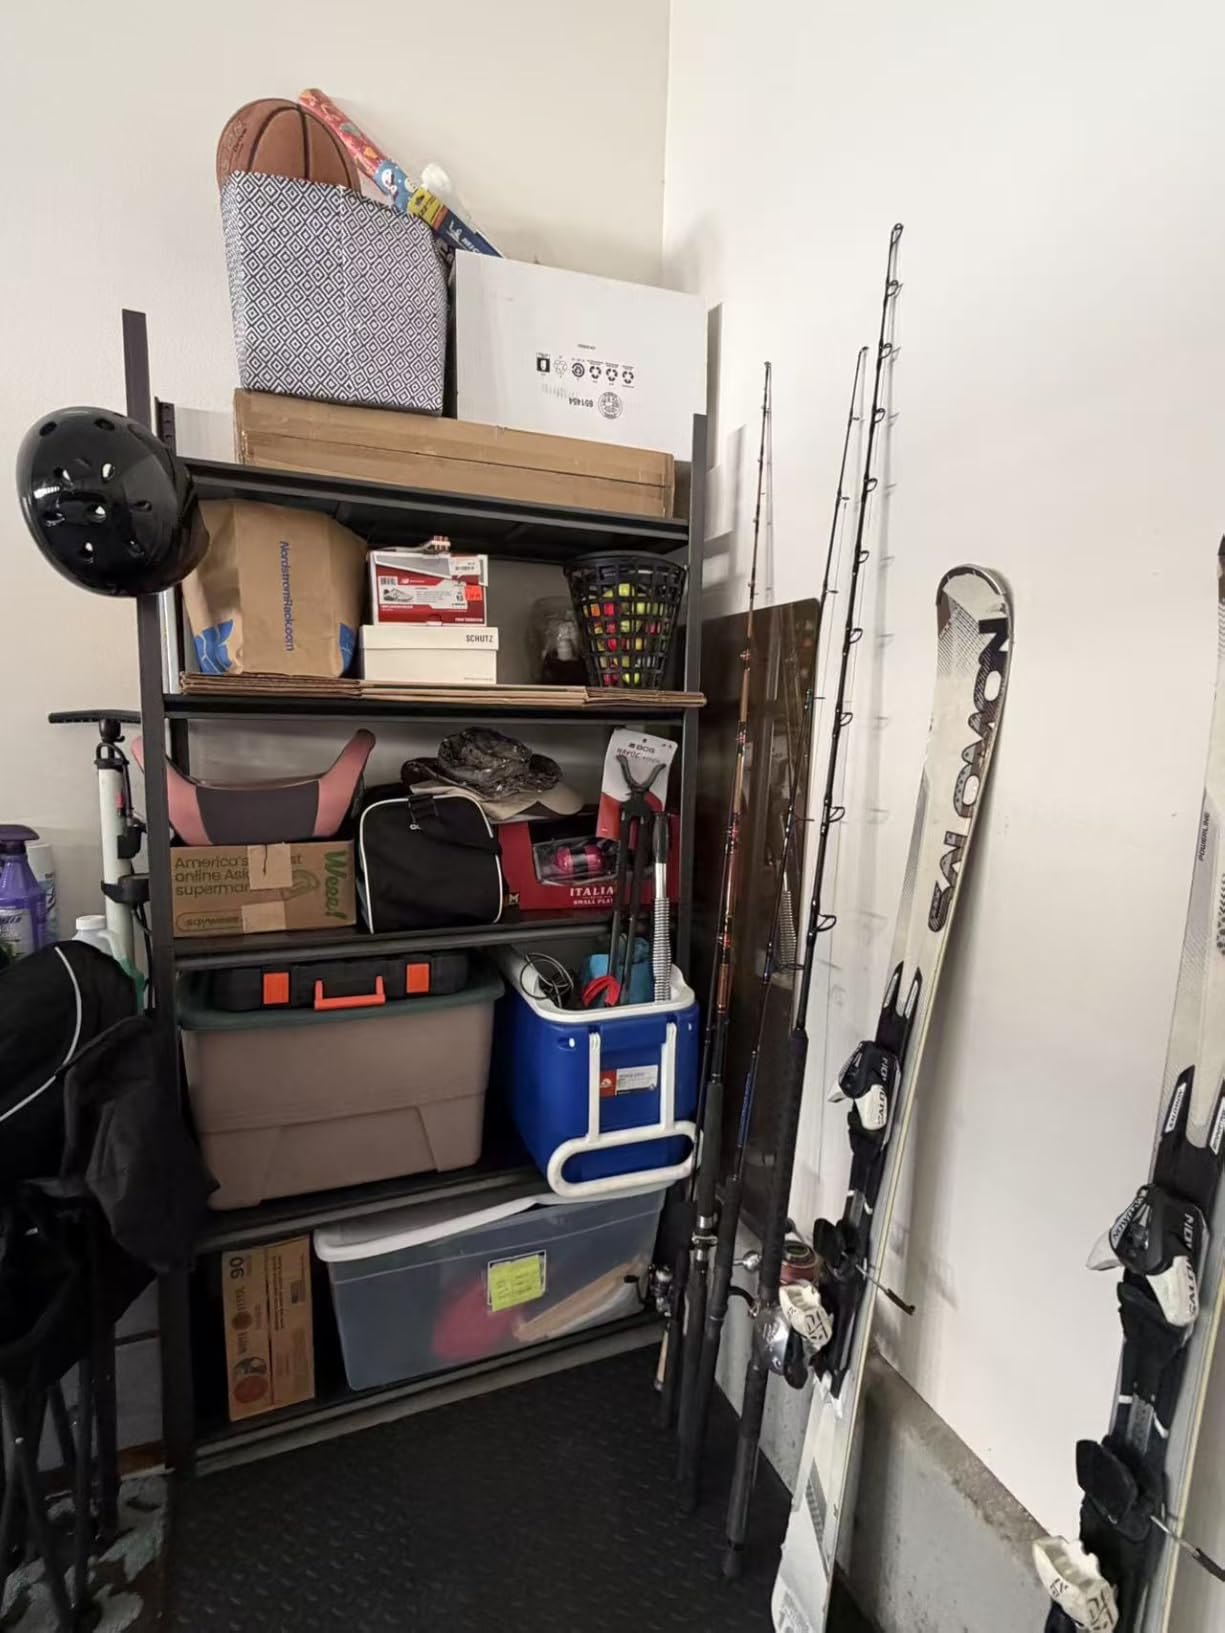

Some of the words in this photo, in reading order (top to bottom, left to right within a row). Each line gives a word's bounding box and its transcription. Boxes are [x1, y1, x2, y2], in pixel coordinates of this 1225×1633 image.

[279, 541, 295, 652] NordstromRack.com
[465, 634, 494, 644] SCHUTZ
[928, 617, 1009, 933] SALOMON
[1197, 811, 1211, 862] POWERLINE
[175, 855, 249, 869] America's
[175, 869, 222, 884] online
[225, 868, 250, 881] Asi
[324, 850, 348, 920] Weee!
[175, 882, 250, 898] supermar
[570, 886, 614, 897] ITALIA
[229, 1256, 245, 1280] 90
